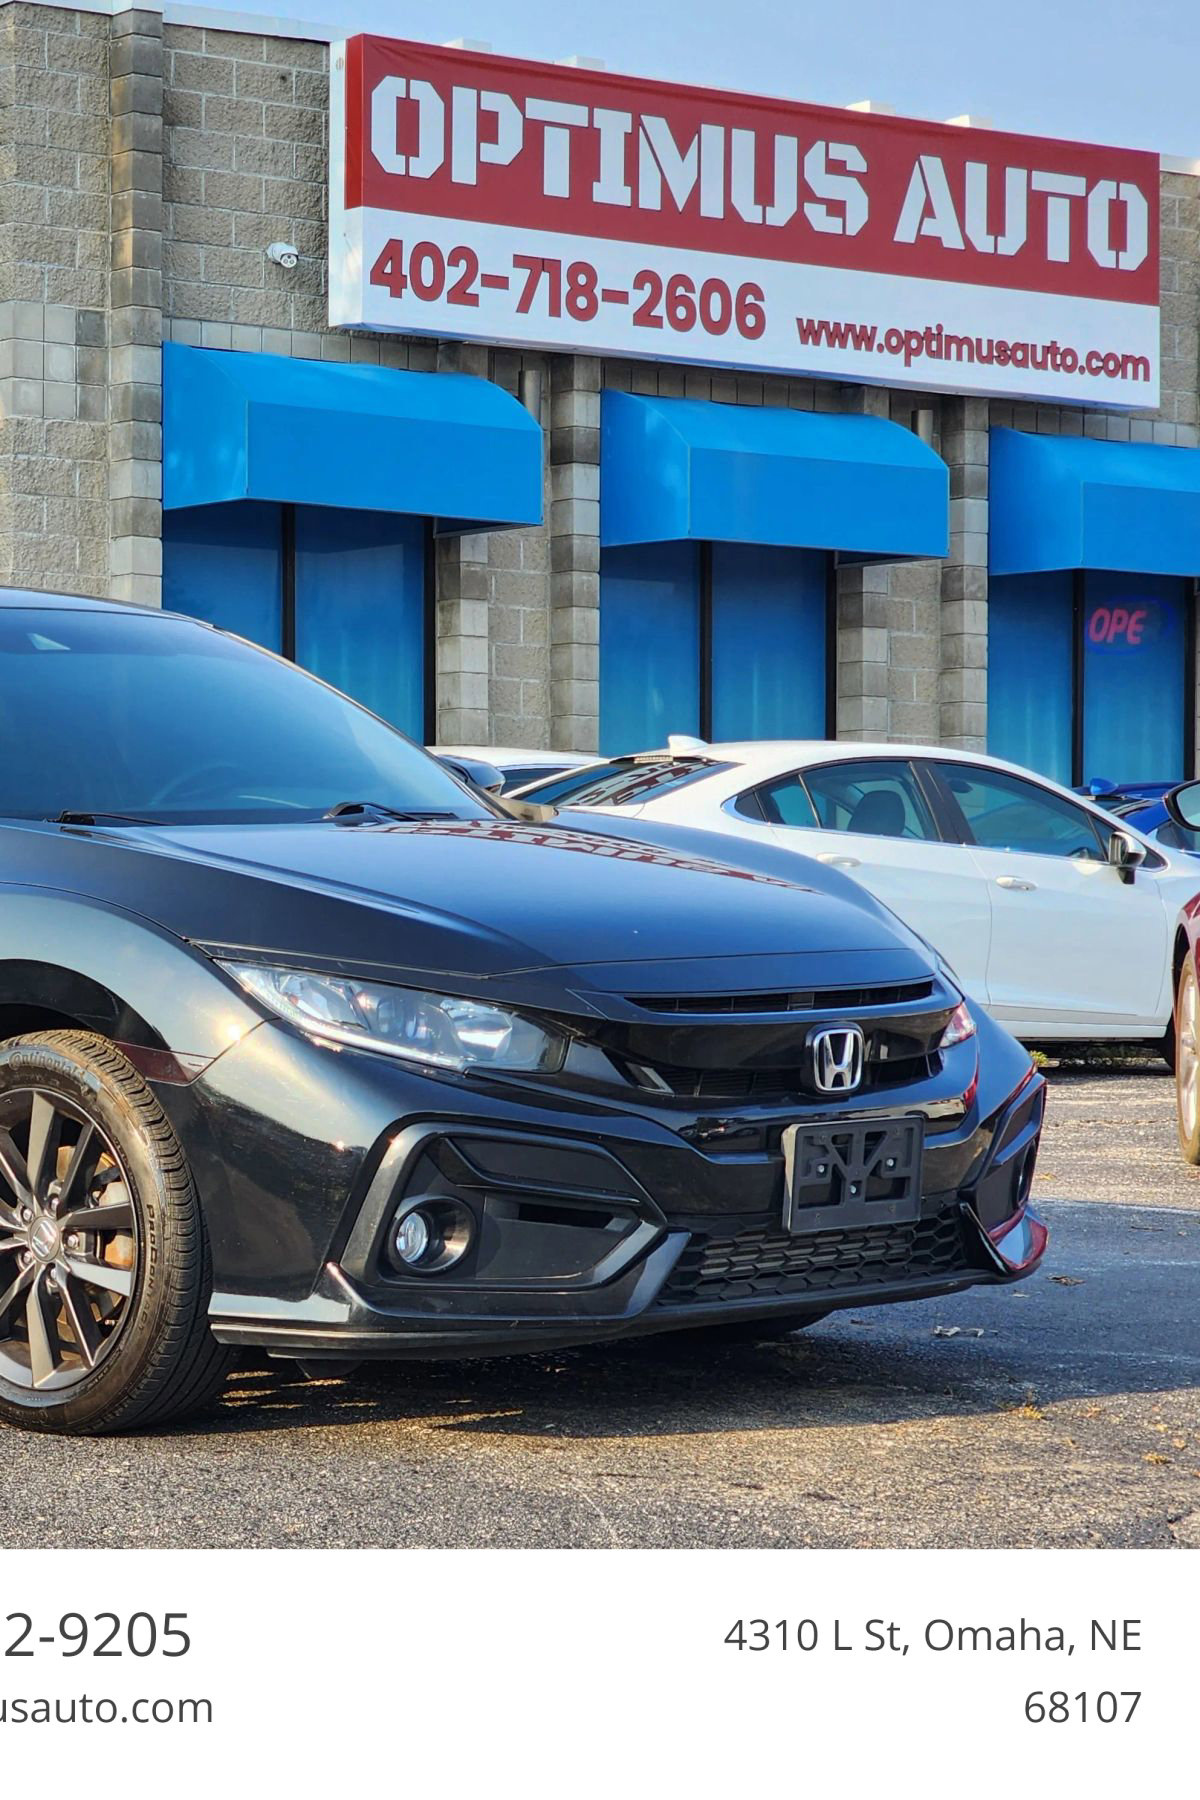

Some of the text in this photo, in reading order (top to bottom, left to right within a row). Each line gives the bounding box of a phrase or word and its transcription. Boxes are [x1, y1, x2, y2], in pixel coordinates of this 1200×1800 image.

[370, 74, 1149, 271] OPTIMUS AUTO
[369, 238, 767, 341] 402-718-2606
[795, 317, 1151, 382] www.optimusauto.com
